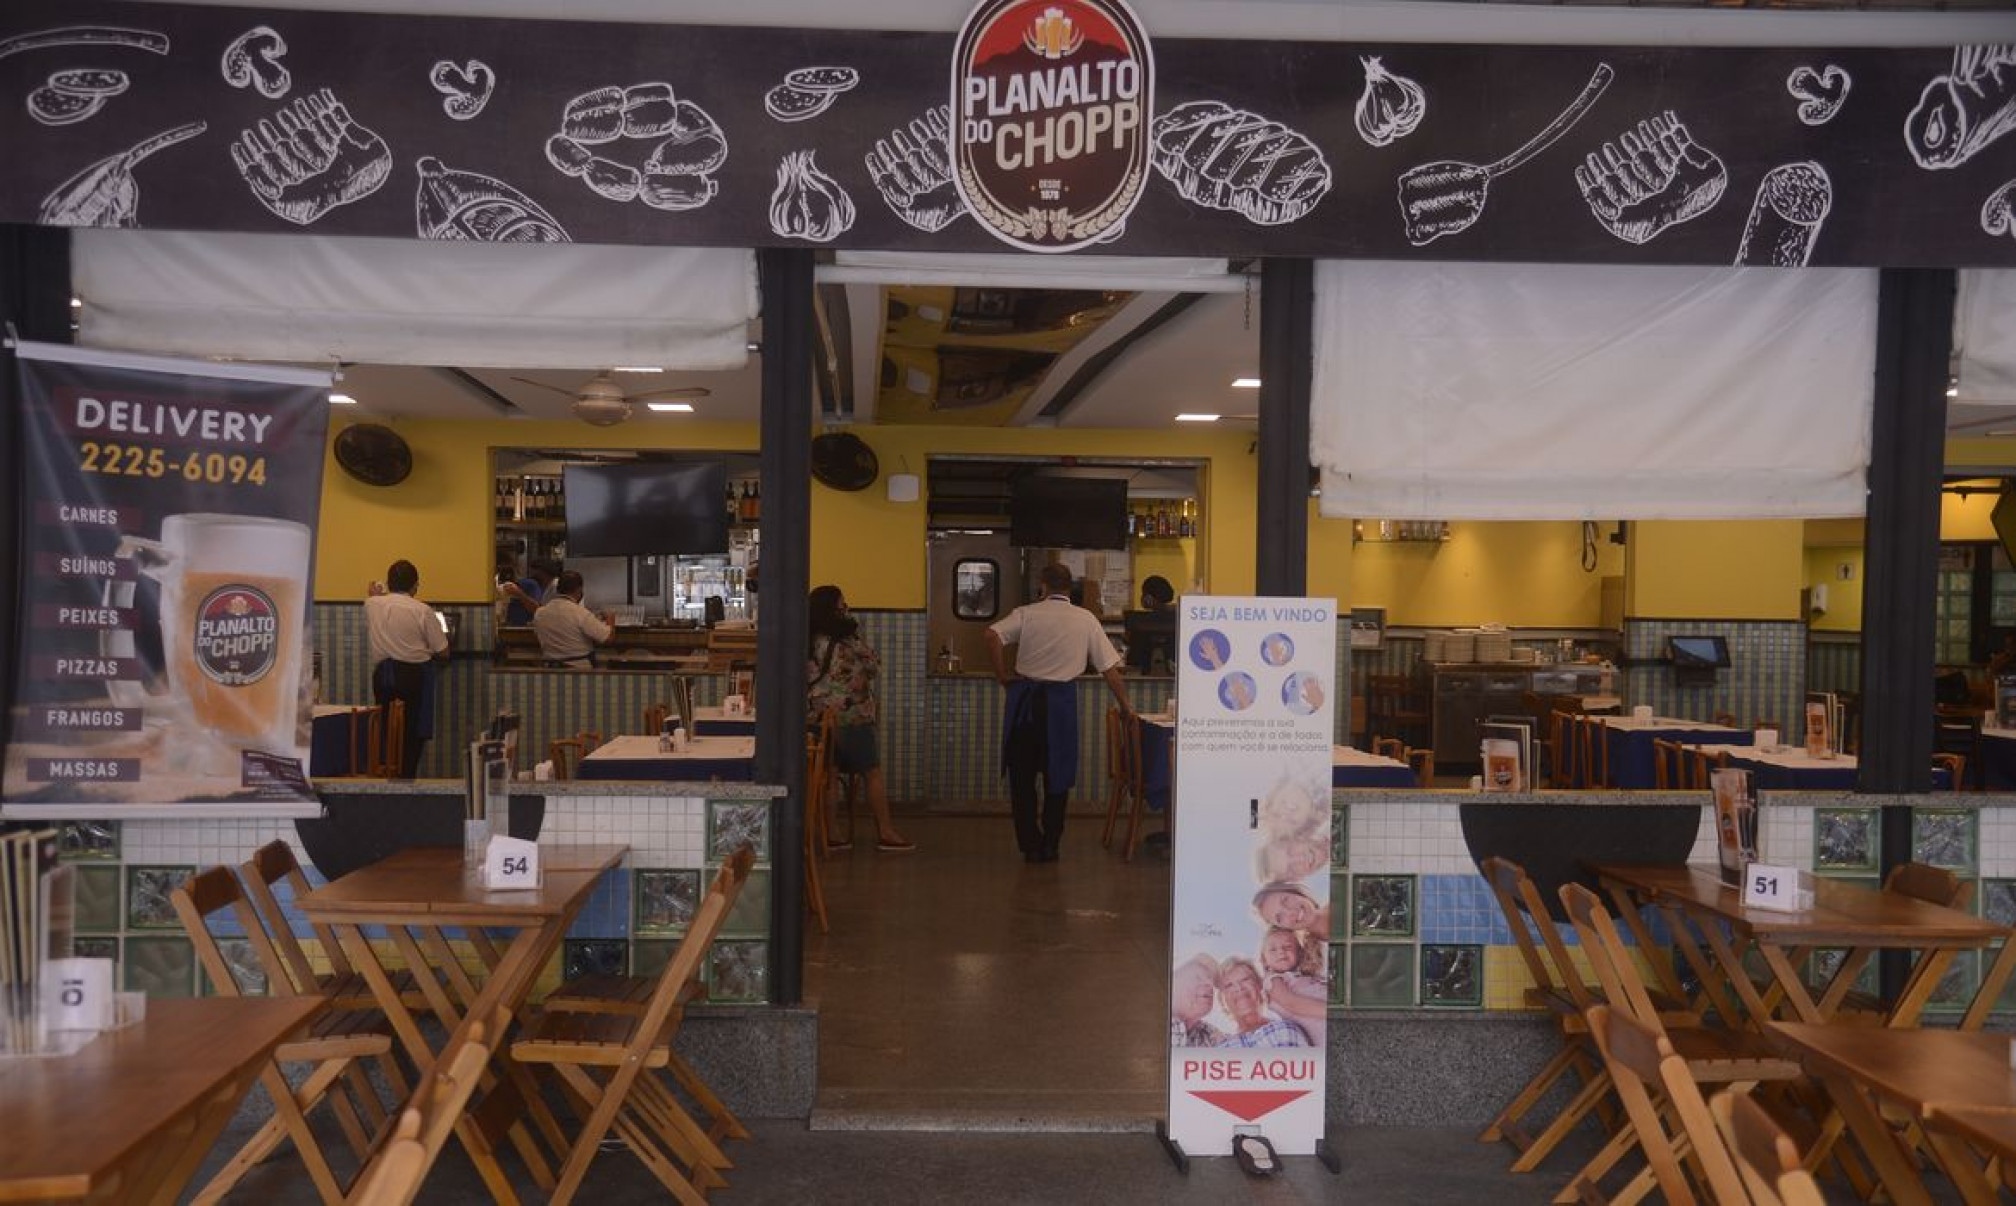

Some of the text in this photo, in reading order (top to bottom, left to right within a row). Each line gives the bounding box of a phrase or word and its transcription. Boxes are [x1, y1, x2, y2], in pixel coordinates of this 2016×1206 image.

[964, 59, 1140, 117] PLANALTO
[964, 102, 1140, 170] DO CHOPP
[76, 398, 273, 443] DELIVERY
[80, 442, 267, 485] 2225-6094
[59, 506, 118, 526] CARNES
[60, 555, 117, 576] SUÍNOS
[59, 607, 119, 626] PEIXES
[1190, 606, 1328, 623] SEJA BEM VINDO
[199, 616, 275, 637] PLANALTO
[198, 633, 274, 658] DO CHOPP
[57, 658, 118, 677] PIZZAS
[47, 710, 124, 727] FRANGOS
[49, 762, 119, 778] MASSAS
[502, 856, 528, 875] 54
[1755, 876, 1778, 896] 51
[1184, 1060, 1315, 1082] PISE AQUI
